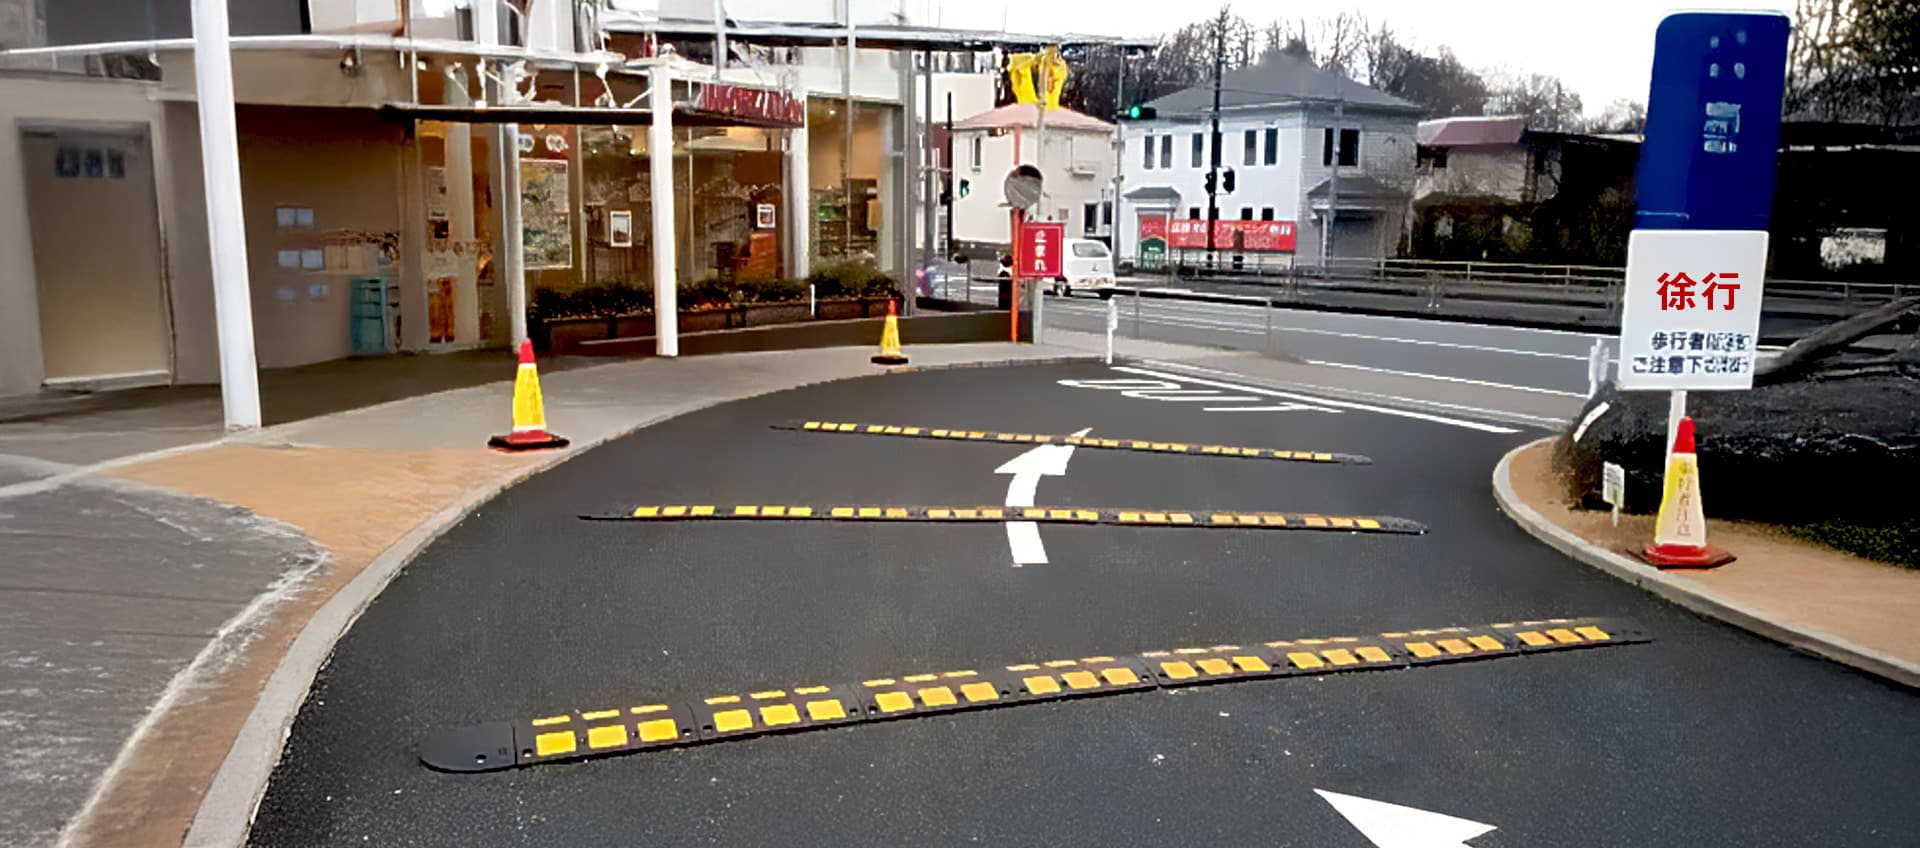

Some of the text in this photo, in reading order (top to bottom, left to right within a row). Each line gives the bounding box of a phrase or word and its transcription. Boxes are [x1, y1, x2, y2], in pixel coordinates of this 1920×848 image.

[1034, 229, 1047, 271] 止まれ
[1656, 271, 1741, 311] 徐行
[1056, 378, 1345, 413] OUT
